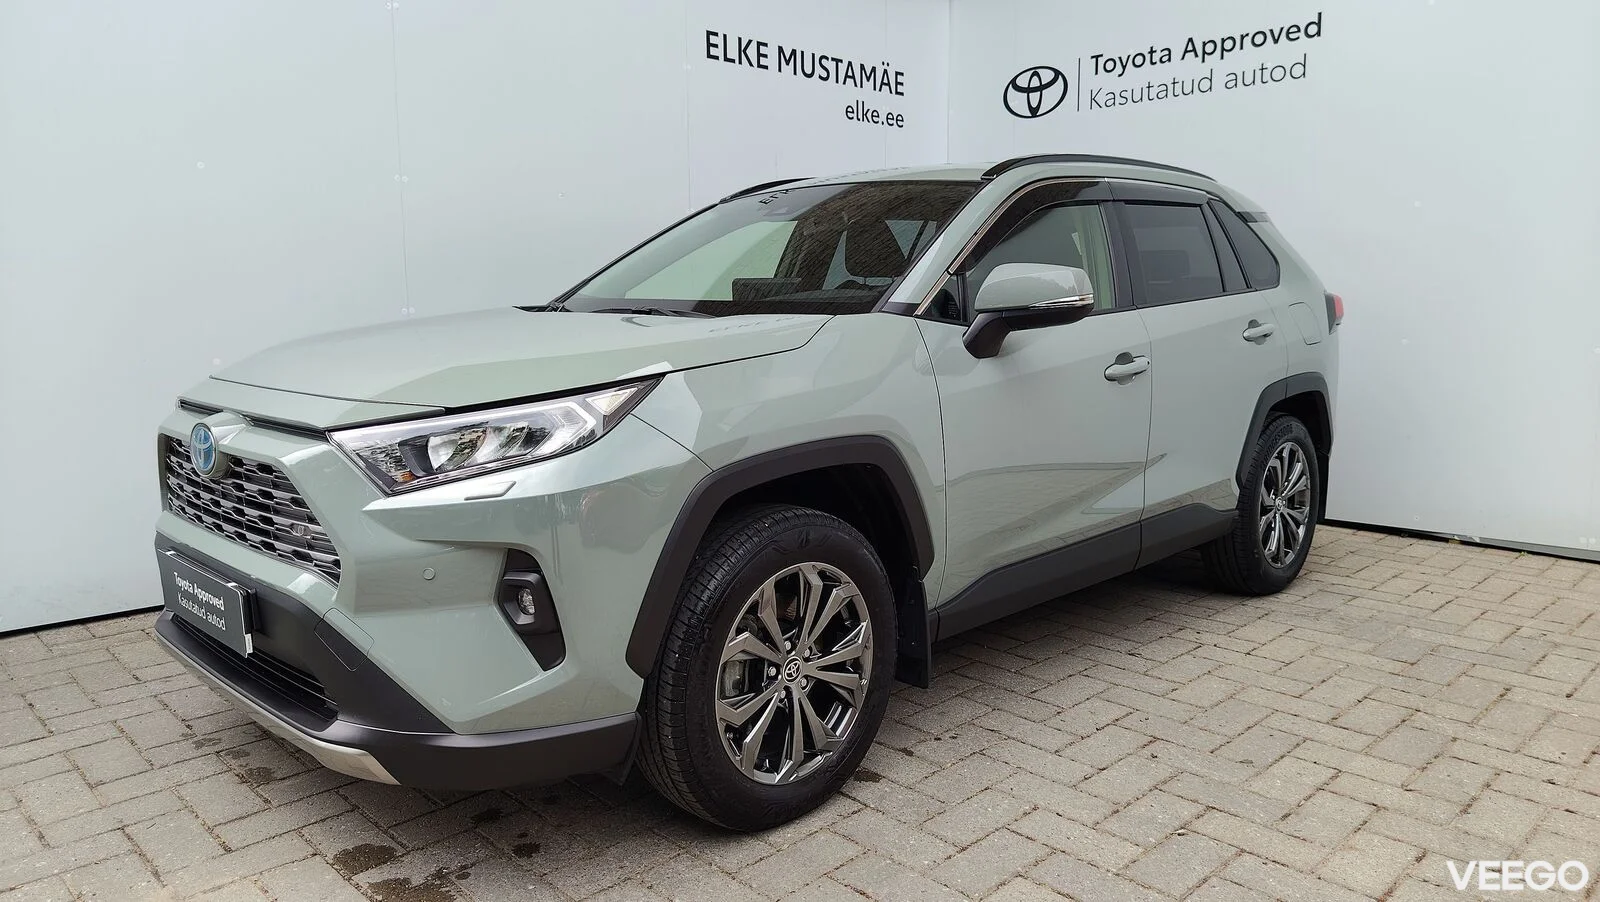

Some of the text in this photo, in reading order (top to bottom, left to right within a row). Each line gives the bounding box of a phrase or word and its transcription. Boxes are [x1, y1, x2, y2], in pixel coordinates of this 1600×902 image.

[706, 30, 905, 96] ELKE MUSTAMÄE
[1091, 12, 1322, 77] Toyota Approved
[1089, 53, 1307, 111] Kasutatud autod
[845, 99, 905, 129] elke.ee
[173, 571, 225, 611] Toyota Approved
[177, 591, 226, 631] Kasutatud autod
